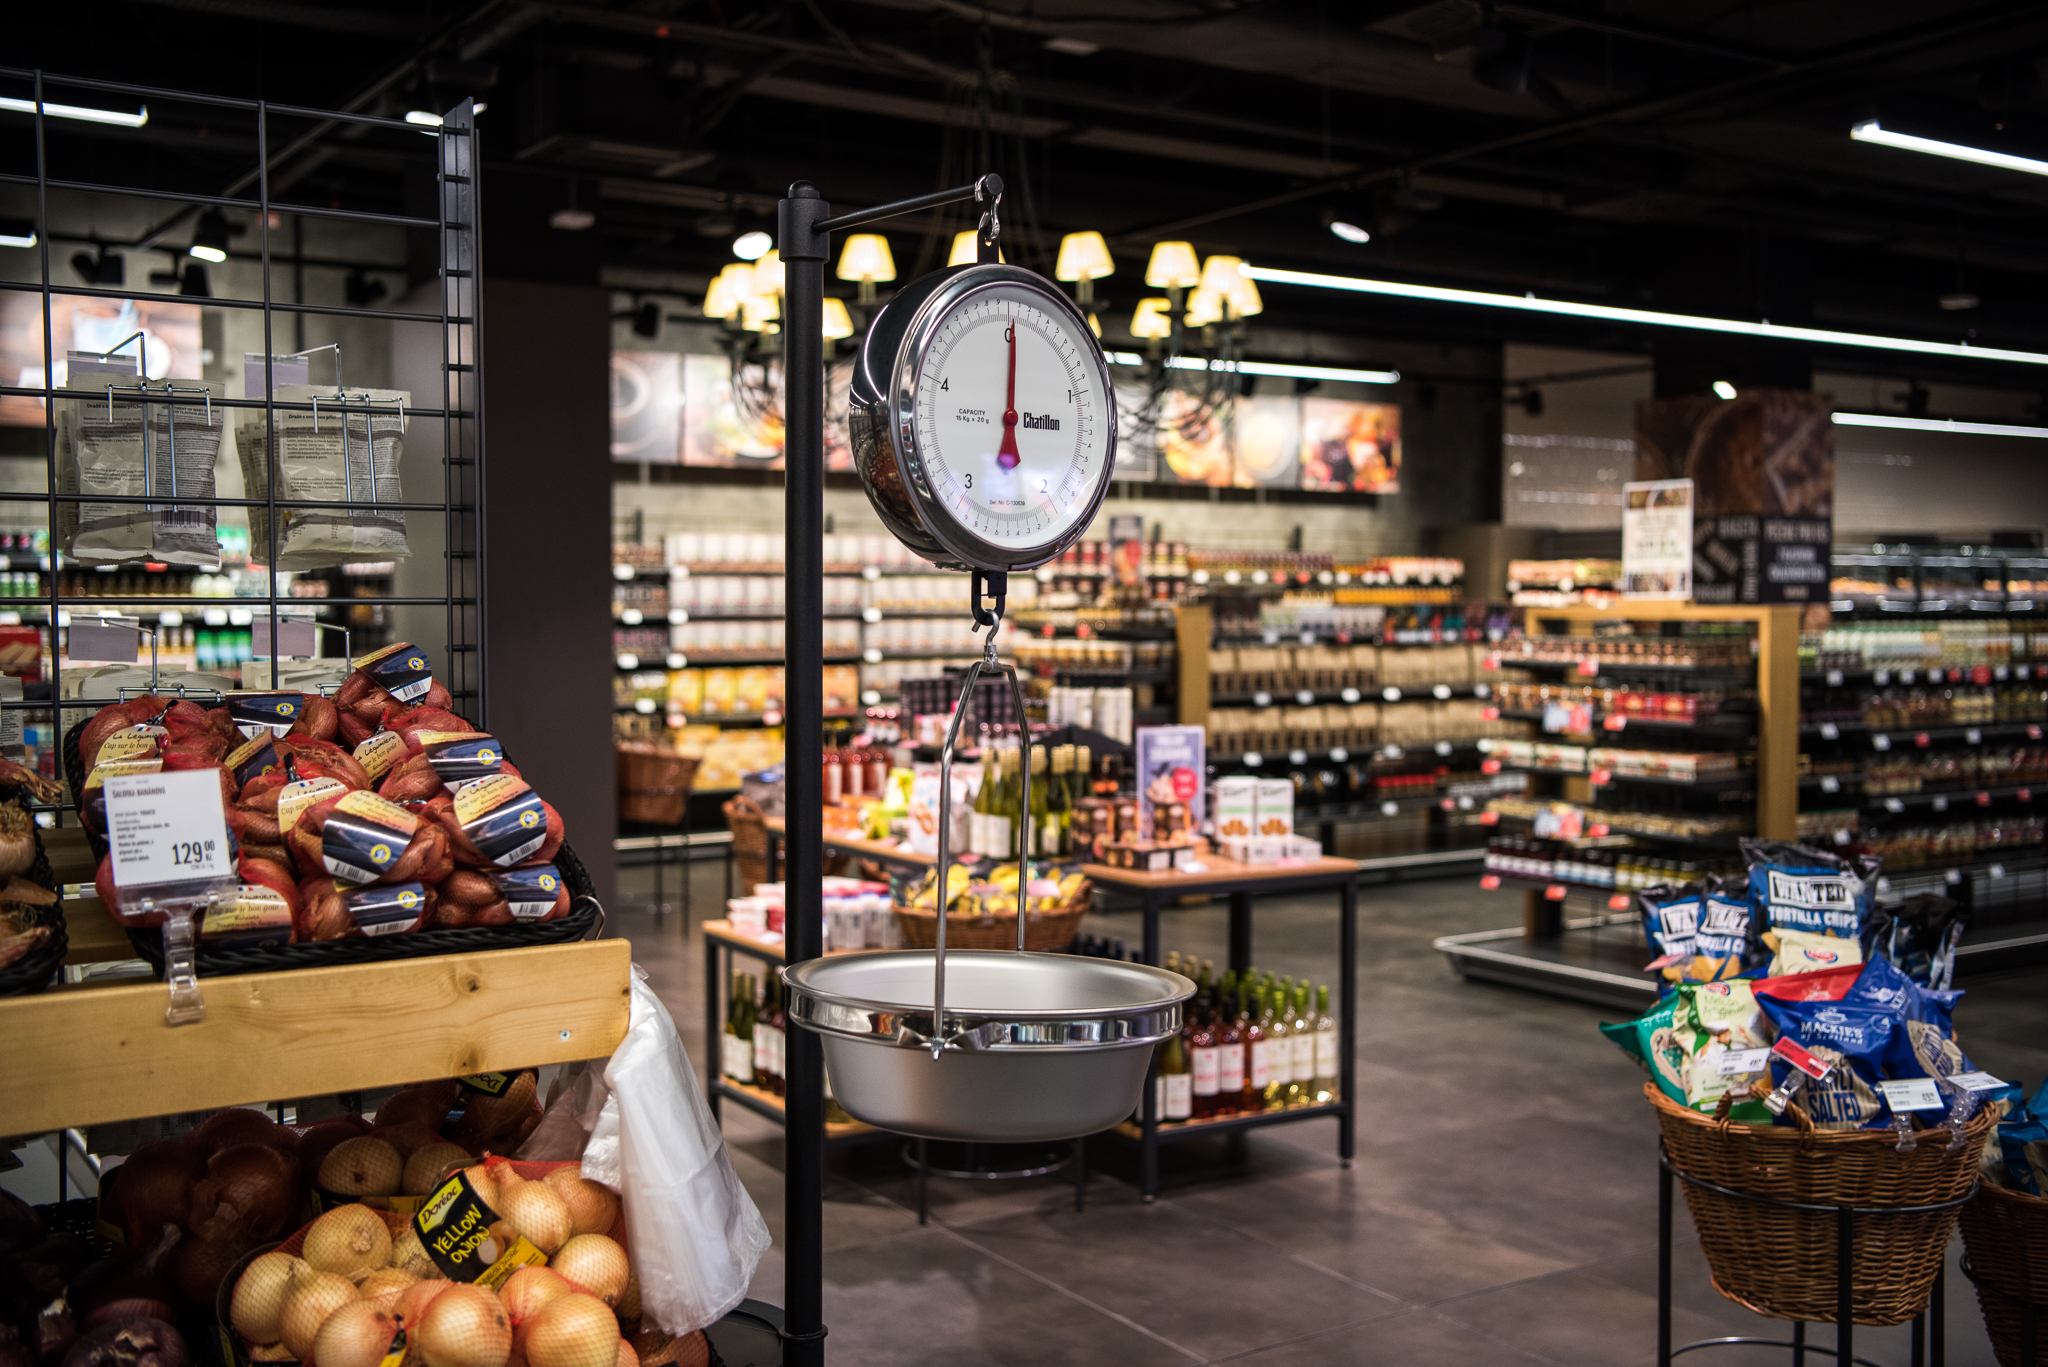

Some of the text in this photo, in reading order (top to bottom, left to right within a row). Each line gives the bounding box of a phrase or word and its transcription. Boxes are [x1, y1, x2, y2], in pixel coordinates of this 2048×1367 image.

[941, 377, 949, 392] 4
[1067, 389, 1072, 404] 1
[959, 408, 986, 416] CAPACITY
[1023, 412, 1060, 431] Chatillon
[965, 473, 973, 489] 3
[1040, 479, 1048, 494] 2
[104, 742, 117, 750] Cap
[281, 807, 294, 815] Cap
[172, 840, 215, 866] 129 00
[1767, 905, 1859, 930] TORTILLA CHIPS
[1801, 1021, 1864, 1039] MACKIE'S
[1801, 1032, 1812, 1042] of
[1808, 1092, 1862, 1122] SALTED
[421, 1185, 459, 1224] Doréoc
[432, 1203, 483, 1255] YELLOW
[450, 1225, 490, 1264] ONION
